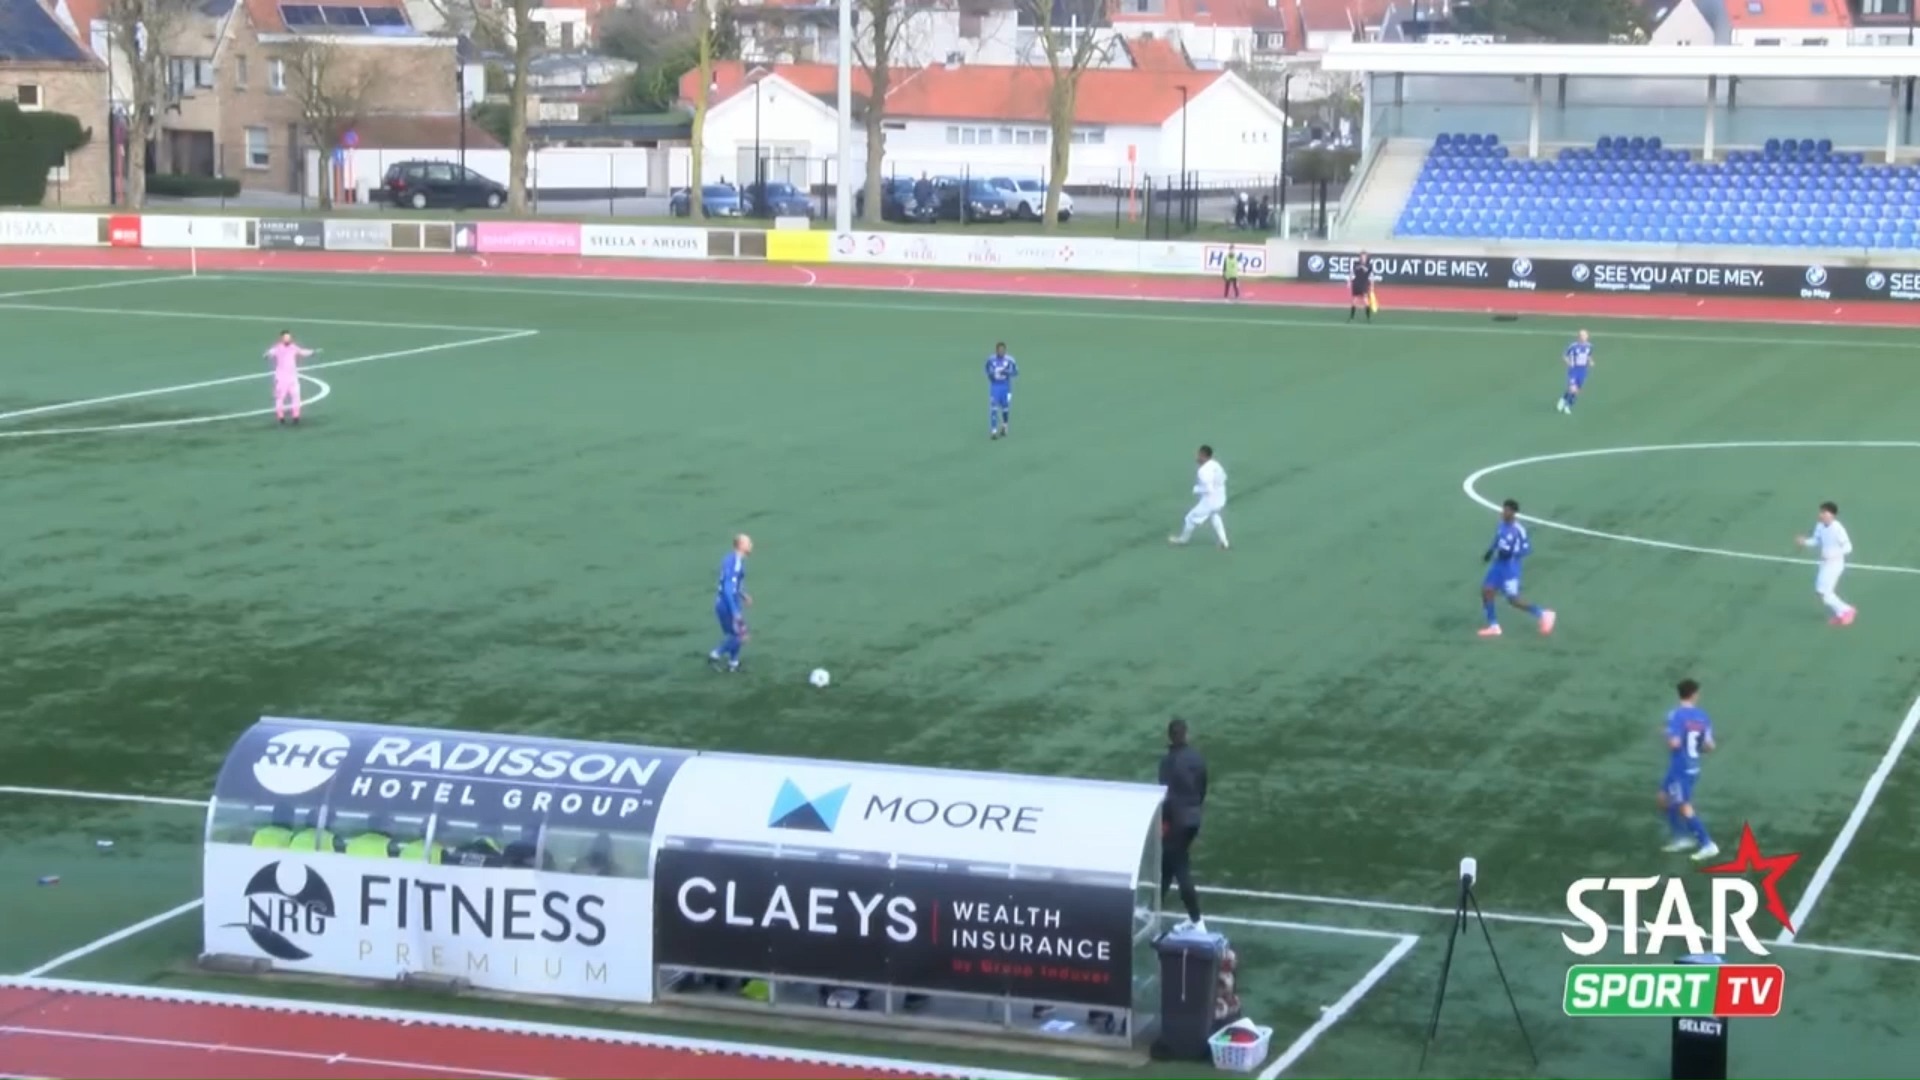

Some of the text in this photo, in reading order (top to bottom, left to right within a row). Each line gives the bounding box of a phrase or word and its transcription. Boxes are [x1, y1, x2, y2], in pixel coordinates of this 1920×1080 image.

[0, 221, 57, 235] ISMA
[590, 237, 699, 250] STELLA ARTOIS
[1369, 257, 1398, 275] OU
[1400, 258, 1419, 276] AT
[1425, 259, 1447, 277] DE
[1451, 260, 1488, 278] MEY.
[1594, 265, 1763, 287] SEE YOU AT DE MEY.
[261, 743, 348, 772] RHG
[365, 736, 661, 787] RADISSON
[351, 776, 475, 806] HOTEL
[864, 794, 1043, 834] MOORE
[247, 897, 327, 936] NRG
[359, 874, 607, 947] FITNESS
[677, 876, 918, 943] CLAEYS
[953, 900, 1061, 930] WEALTH
[953, 929, 1111, 961] INSURANCE
[359, 939, 609, 984] PREMIUM
[1679, 1018, 1722, 1036] SELECT
